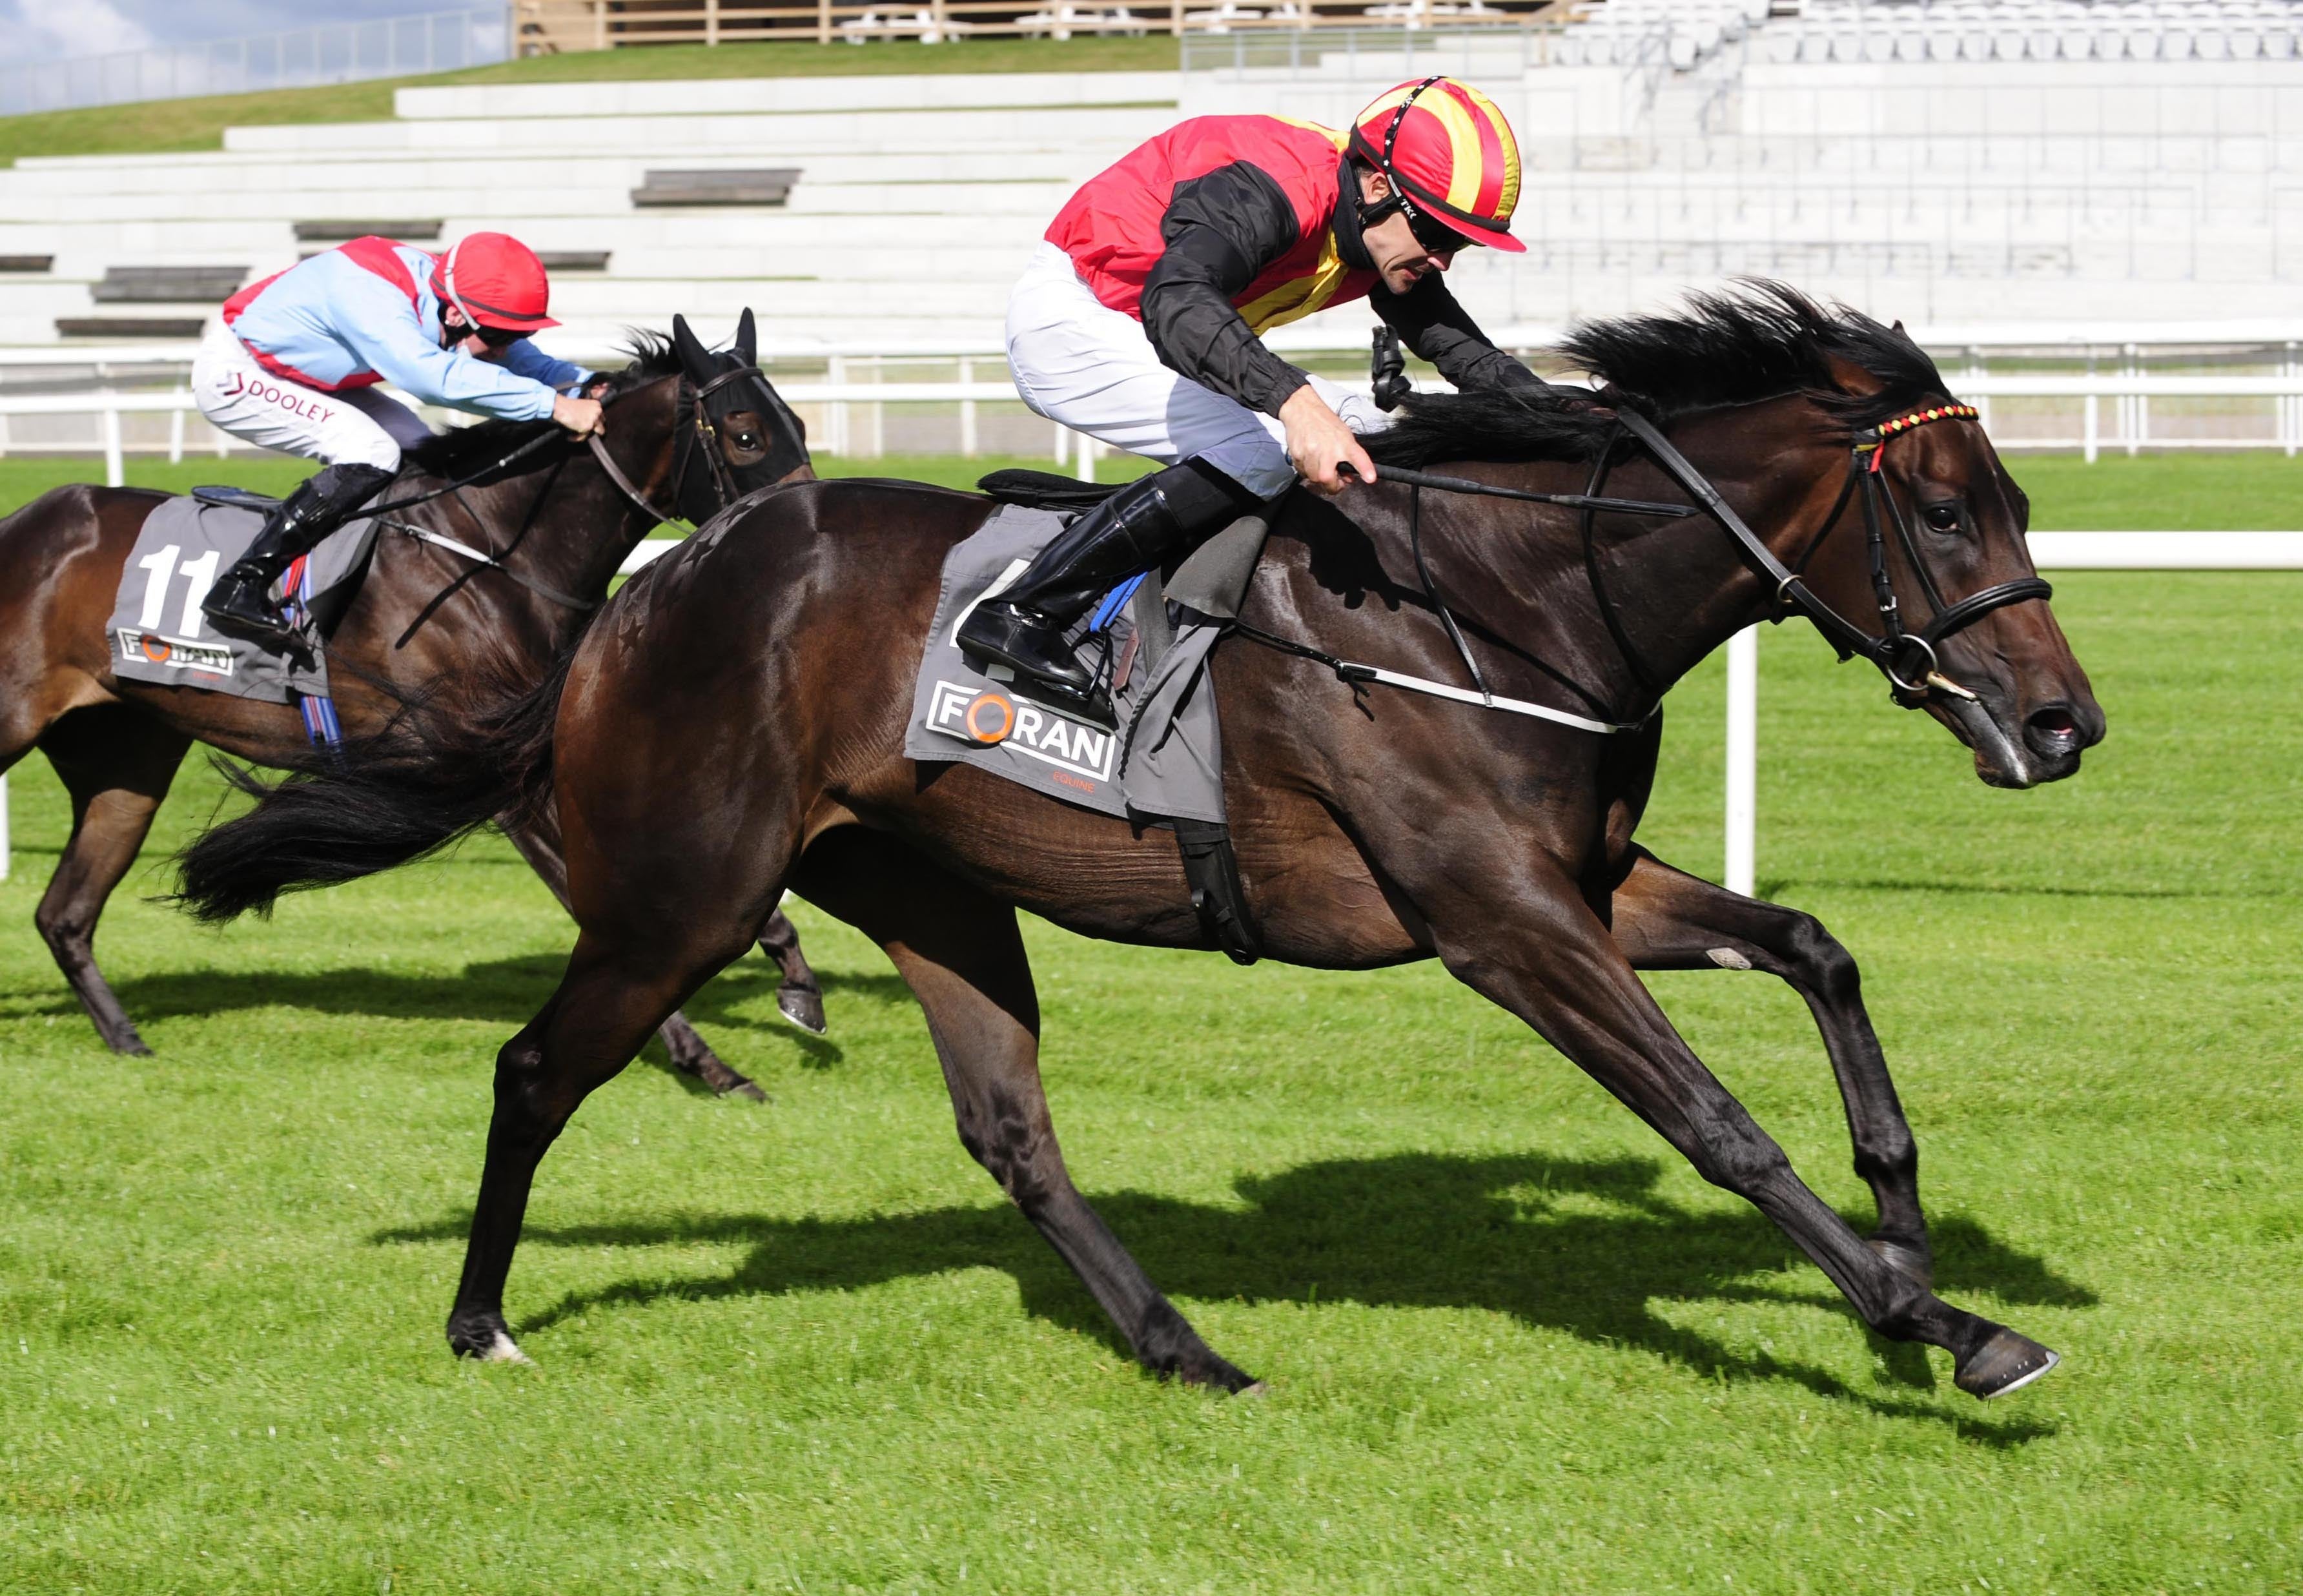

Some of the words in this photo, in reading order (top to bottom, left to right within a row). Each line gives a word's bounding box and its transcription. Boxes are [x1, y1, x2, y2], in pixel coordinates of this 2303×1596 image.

[248, 380, 336, 424] DOOLEY
[138, 544, 221, 639] 11
[126, 635, 230, 668] FORAN
[937, 693, 1108, 769] FORAN
[1053, 770, 1096, 794] EQUINE
